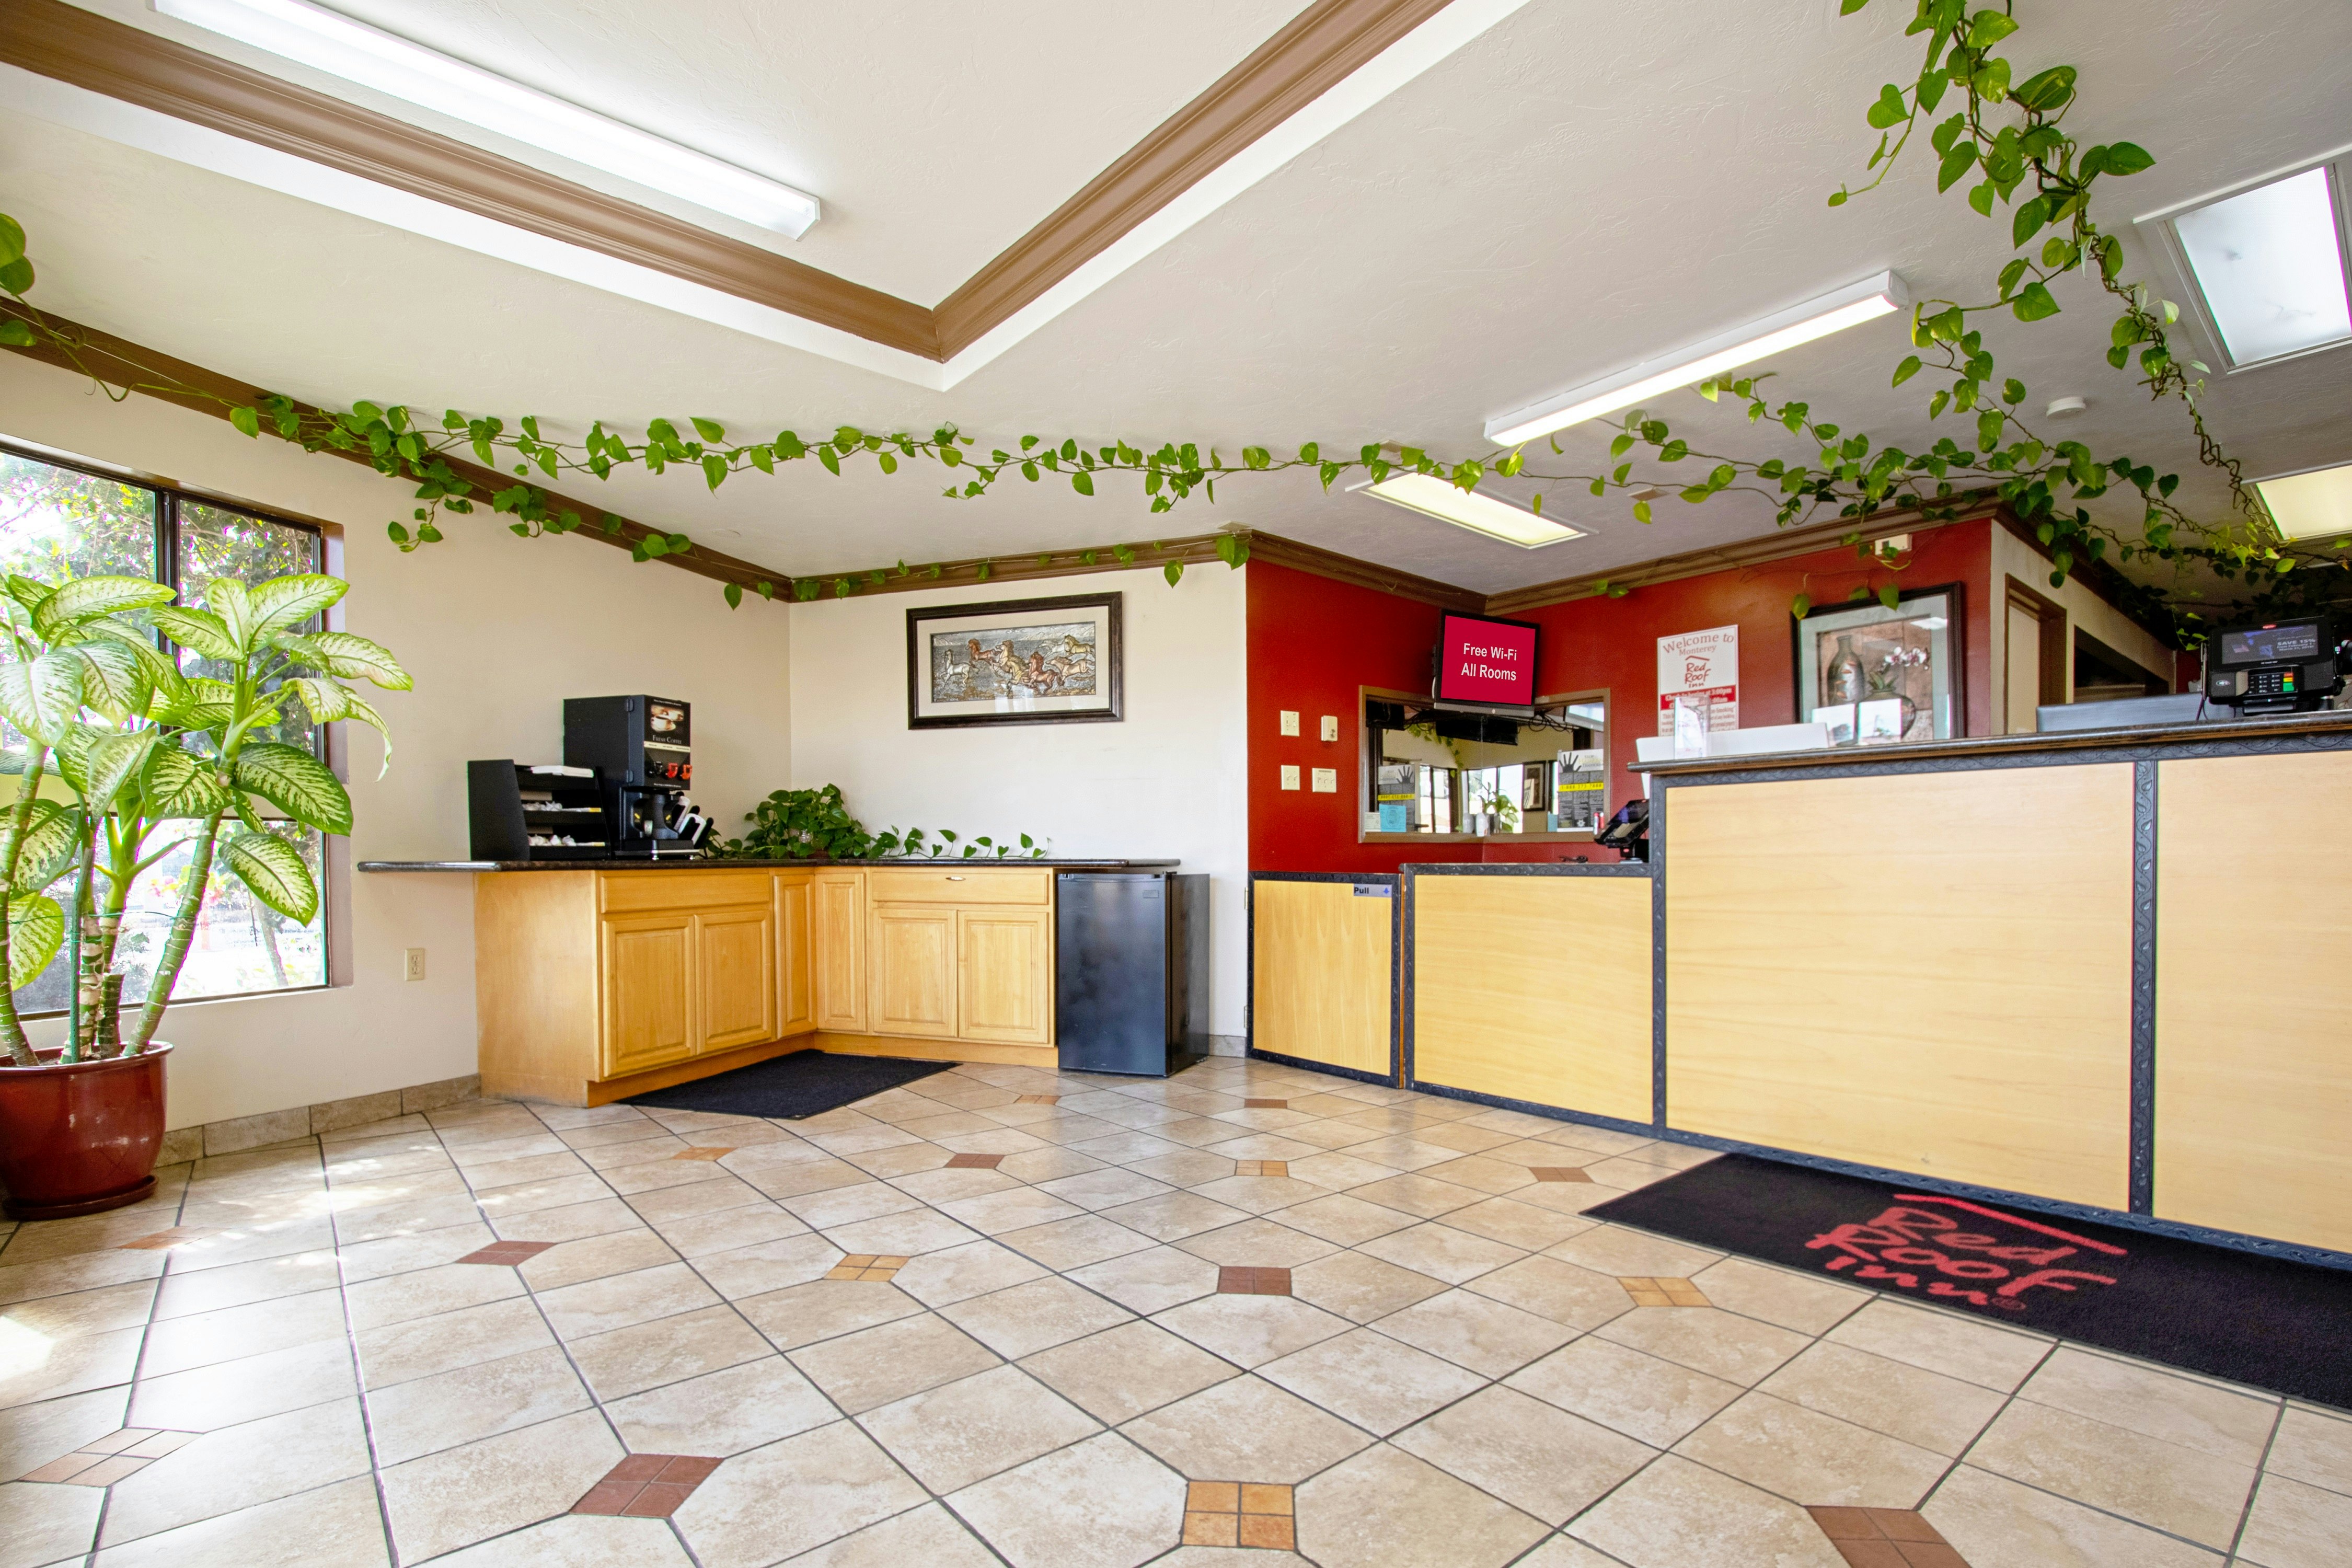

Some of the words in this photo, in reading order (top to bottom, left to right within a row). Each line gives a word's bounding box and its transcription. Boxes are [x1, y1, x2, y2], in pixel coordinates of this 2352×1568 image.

[1463, 643, 1488, 657] Free
[1491, 646, 1517, 661] Wi-Fi
[1663, 634, 1719, 653] Welcome
[1723, 633, 1734, 643] to
[1679, 644, 1717, 656] Monterey
[1461, 662, 1477, 677] All
[1480, 664, 1516, 681] Rooms
[1685, 668, 1711, 684] Roof
[1686, 662, 1707, 673] Red
[1866, 1206, 2077, 1265] Red
[1805, 1224, 2117, 1296] Roof
[1825, 1255, 1988, 1305] inn
